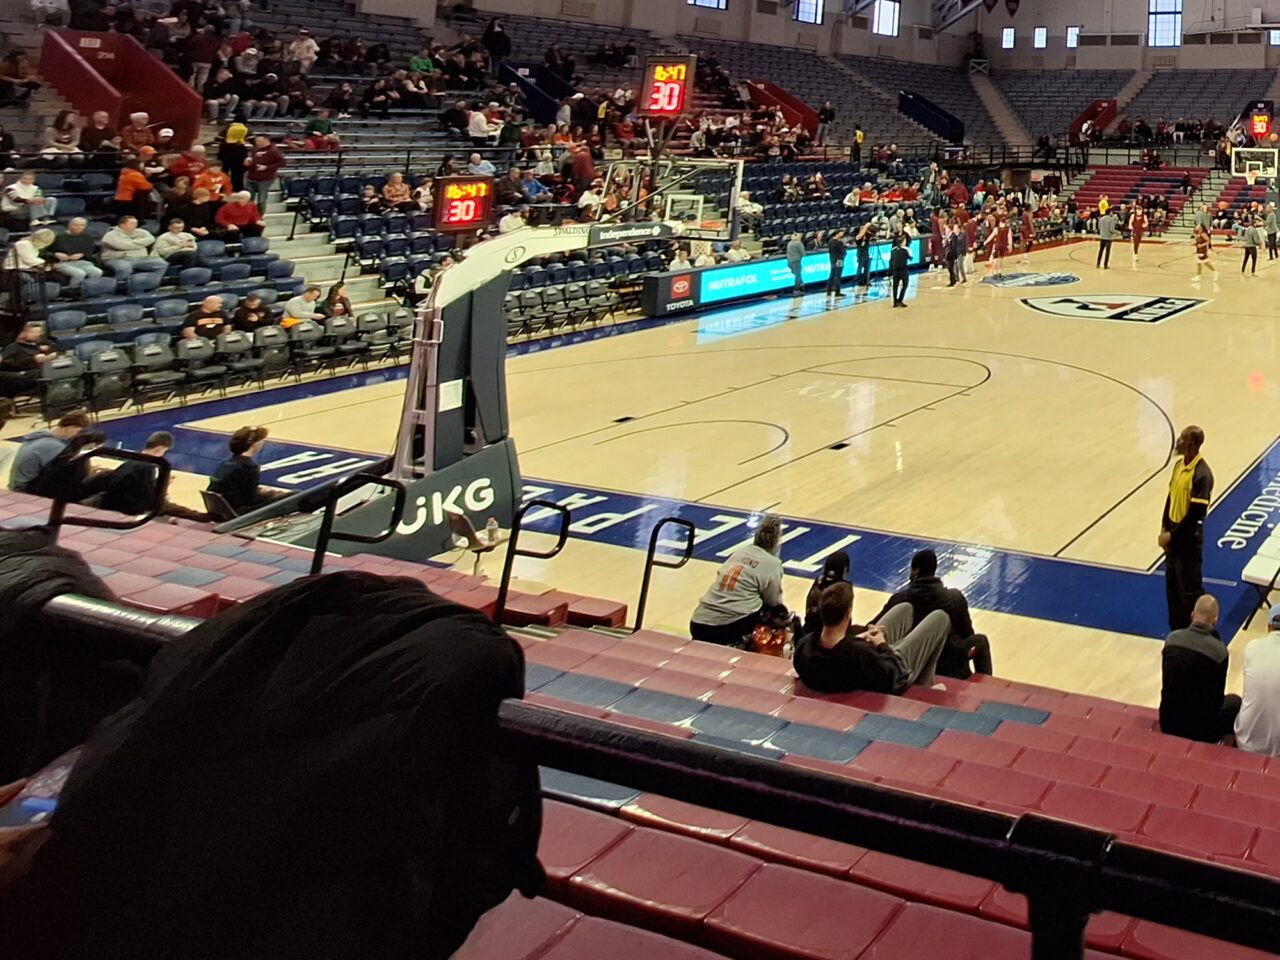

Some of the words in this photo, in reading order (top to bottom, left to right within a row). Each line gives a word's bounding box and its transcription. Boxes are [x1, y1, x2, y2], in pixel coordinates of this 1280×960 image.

[650, 82, 680, 110] 30
[1254, 122, 1267, 133] 30
[446, 182, 487, 199] 16:47
[449, 200, 475, 222] 30
[600, 227, 652, 240] Independence
[666, 299, 694, 312] TOYOTA
